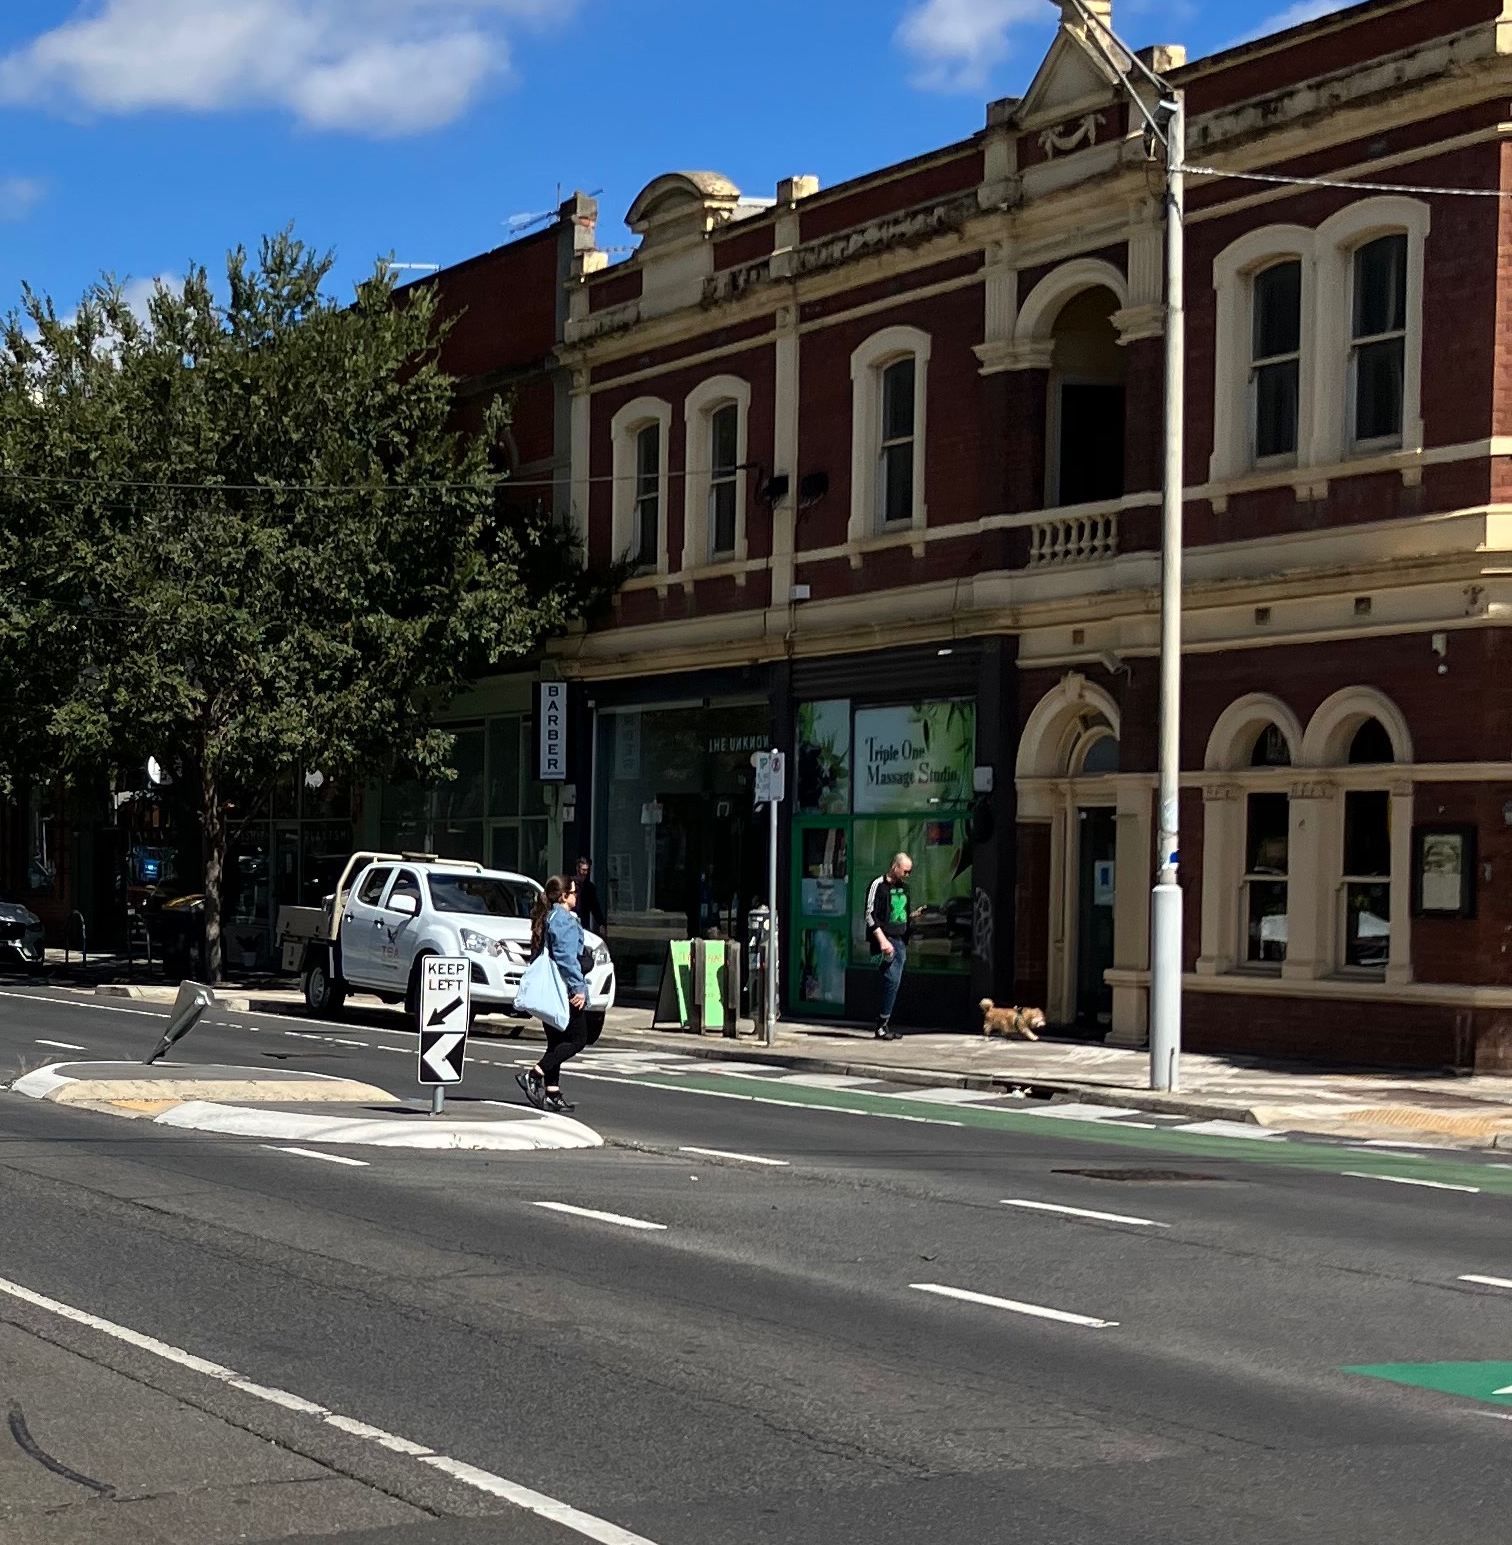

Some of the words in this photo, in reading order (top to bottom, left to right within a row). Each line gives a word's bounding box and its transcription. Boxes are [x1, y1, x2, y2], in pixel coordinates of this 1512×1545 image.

[547, 685, 559, 770] BARBER
[865, 736, 899, 765] Triple
[901, 739, 925, 760] One
[866, 764, 915, 789] Massage
[428, 962, 465, 975] KEEP
[428, 979, 464, 991] LEFT
